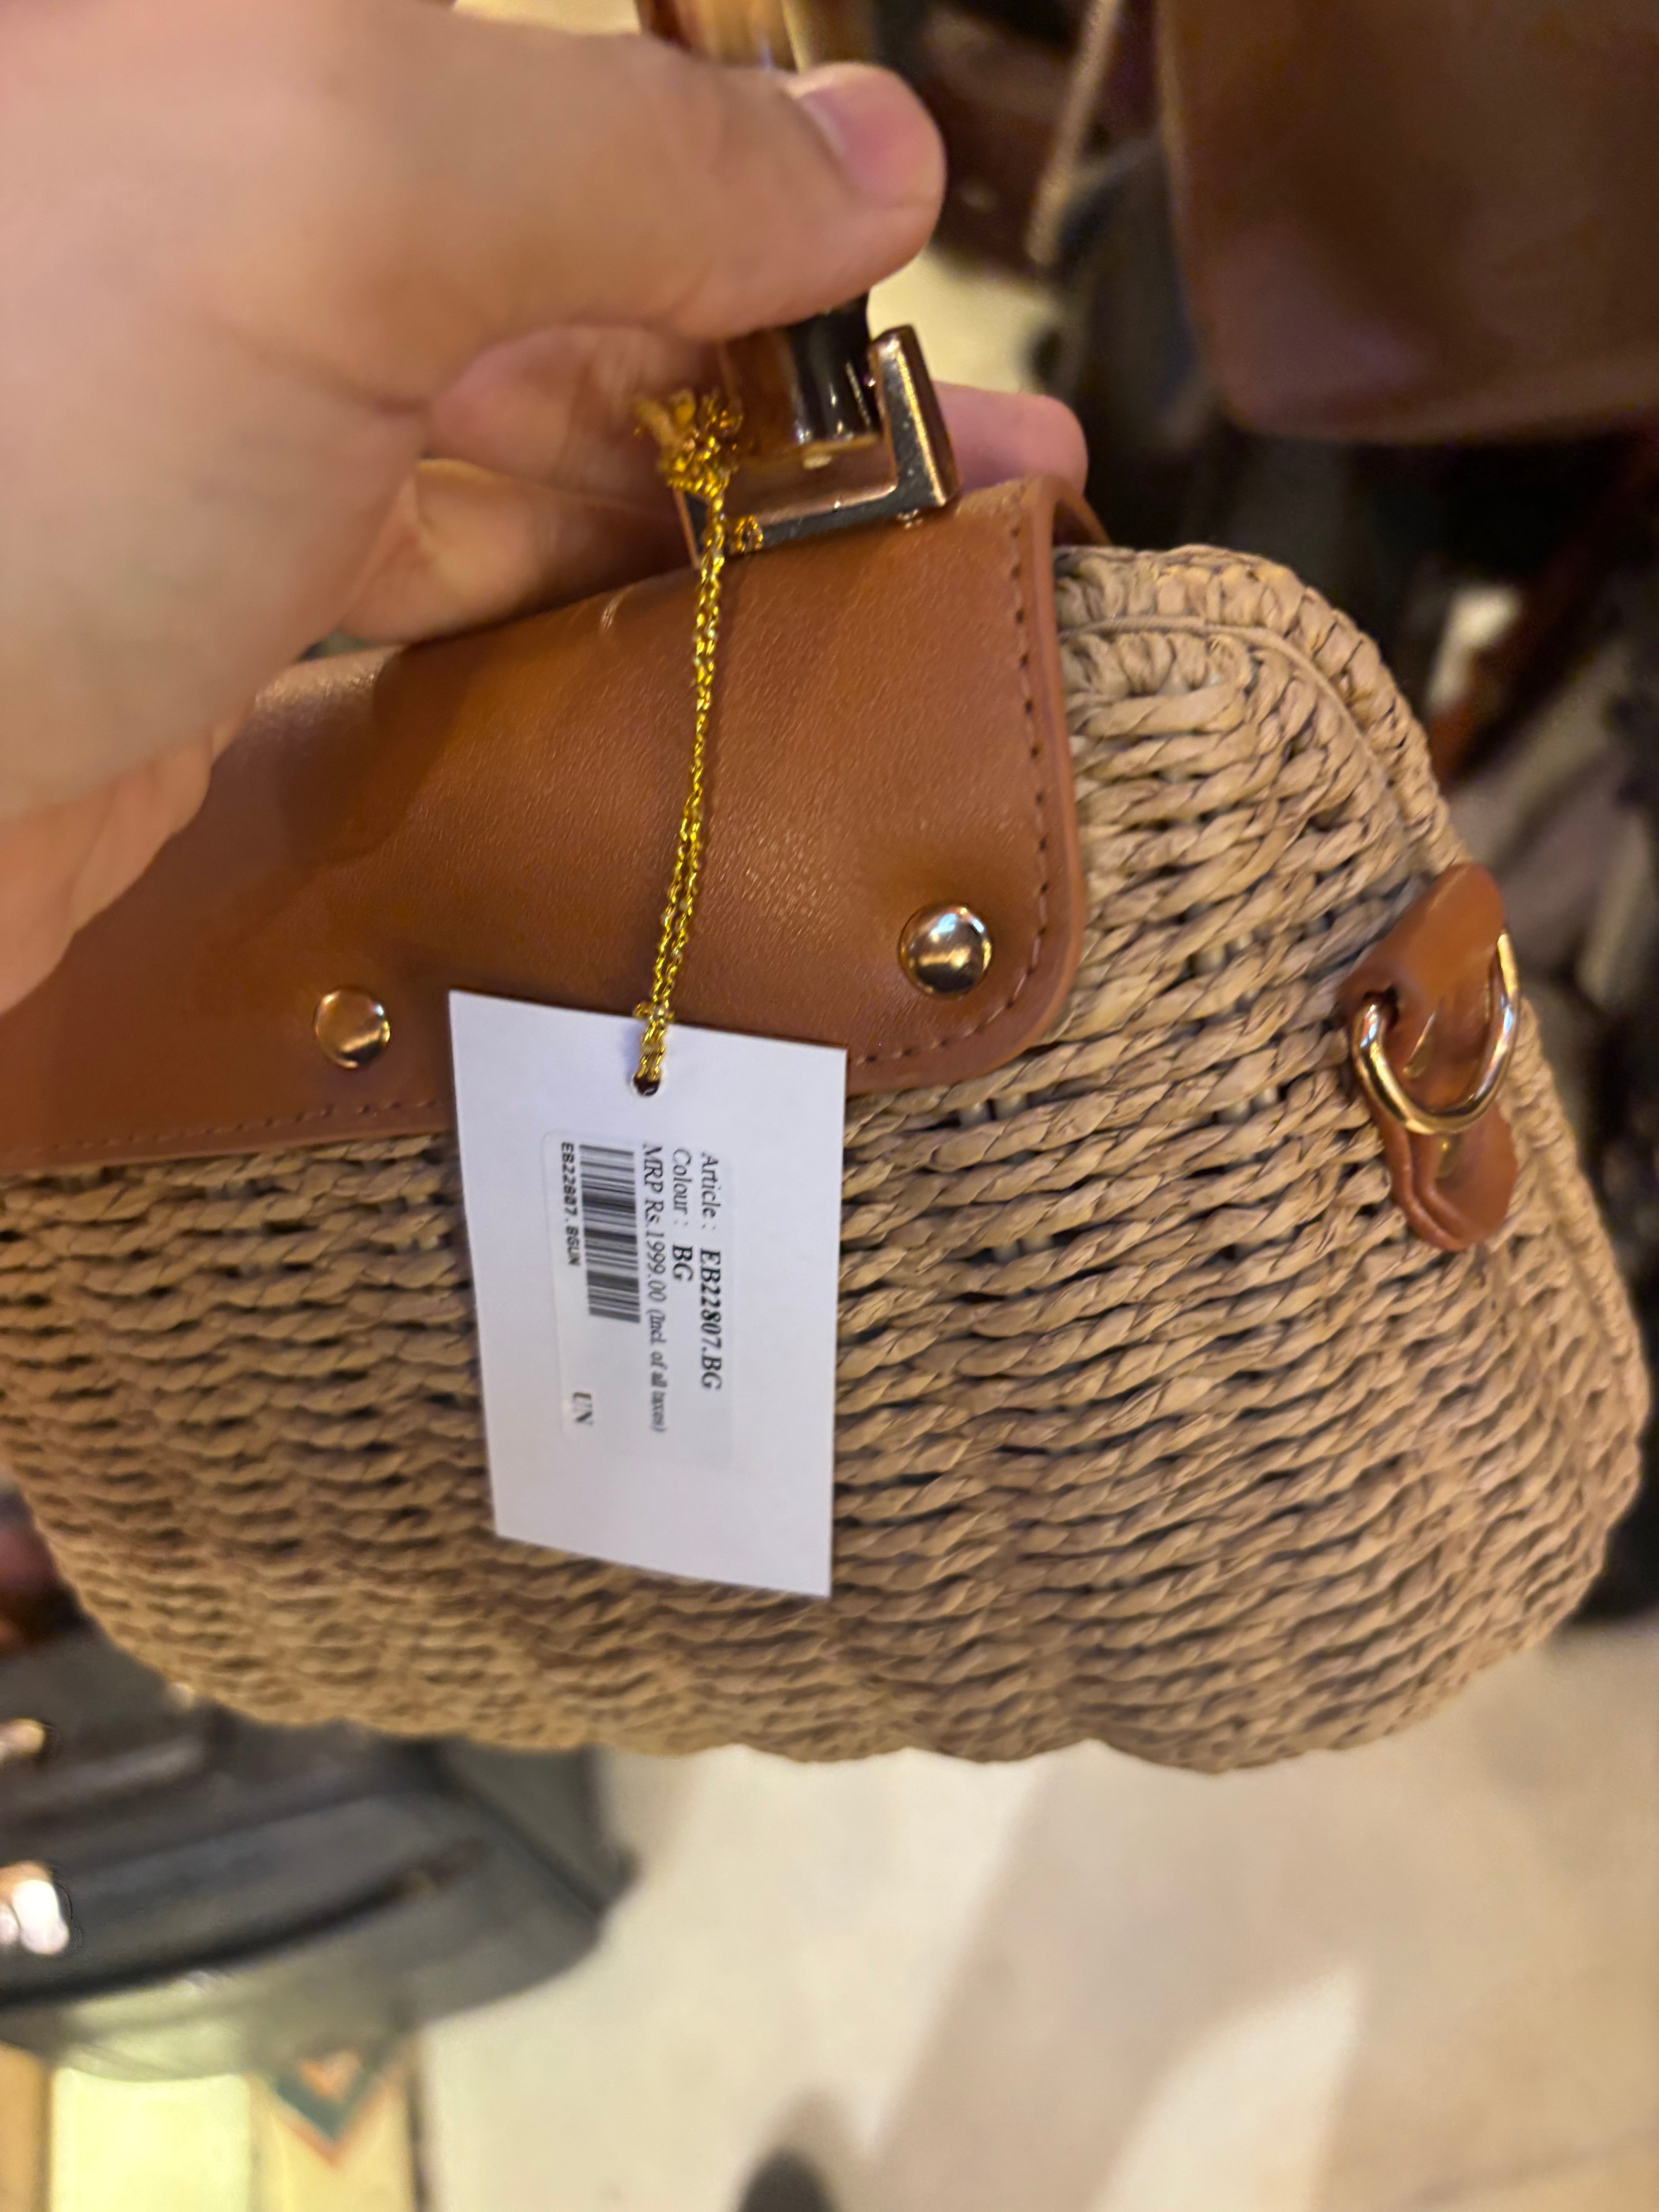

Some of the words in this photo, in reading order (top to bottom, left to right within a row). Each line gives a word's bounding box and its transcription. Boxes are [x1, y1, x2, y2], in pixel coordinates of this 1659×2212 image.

[643, 1143, 663, 1192] MRP
[673, 1245, 693, 1281] BG
[701, 1248, 722, 1390] EB22807.BG
[650, 1350, 667, 1369] of
[651, 1370, 667, 1388] all
[572, 1391, 593, 1425] UN
